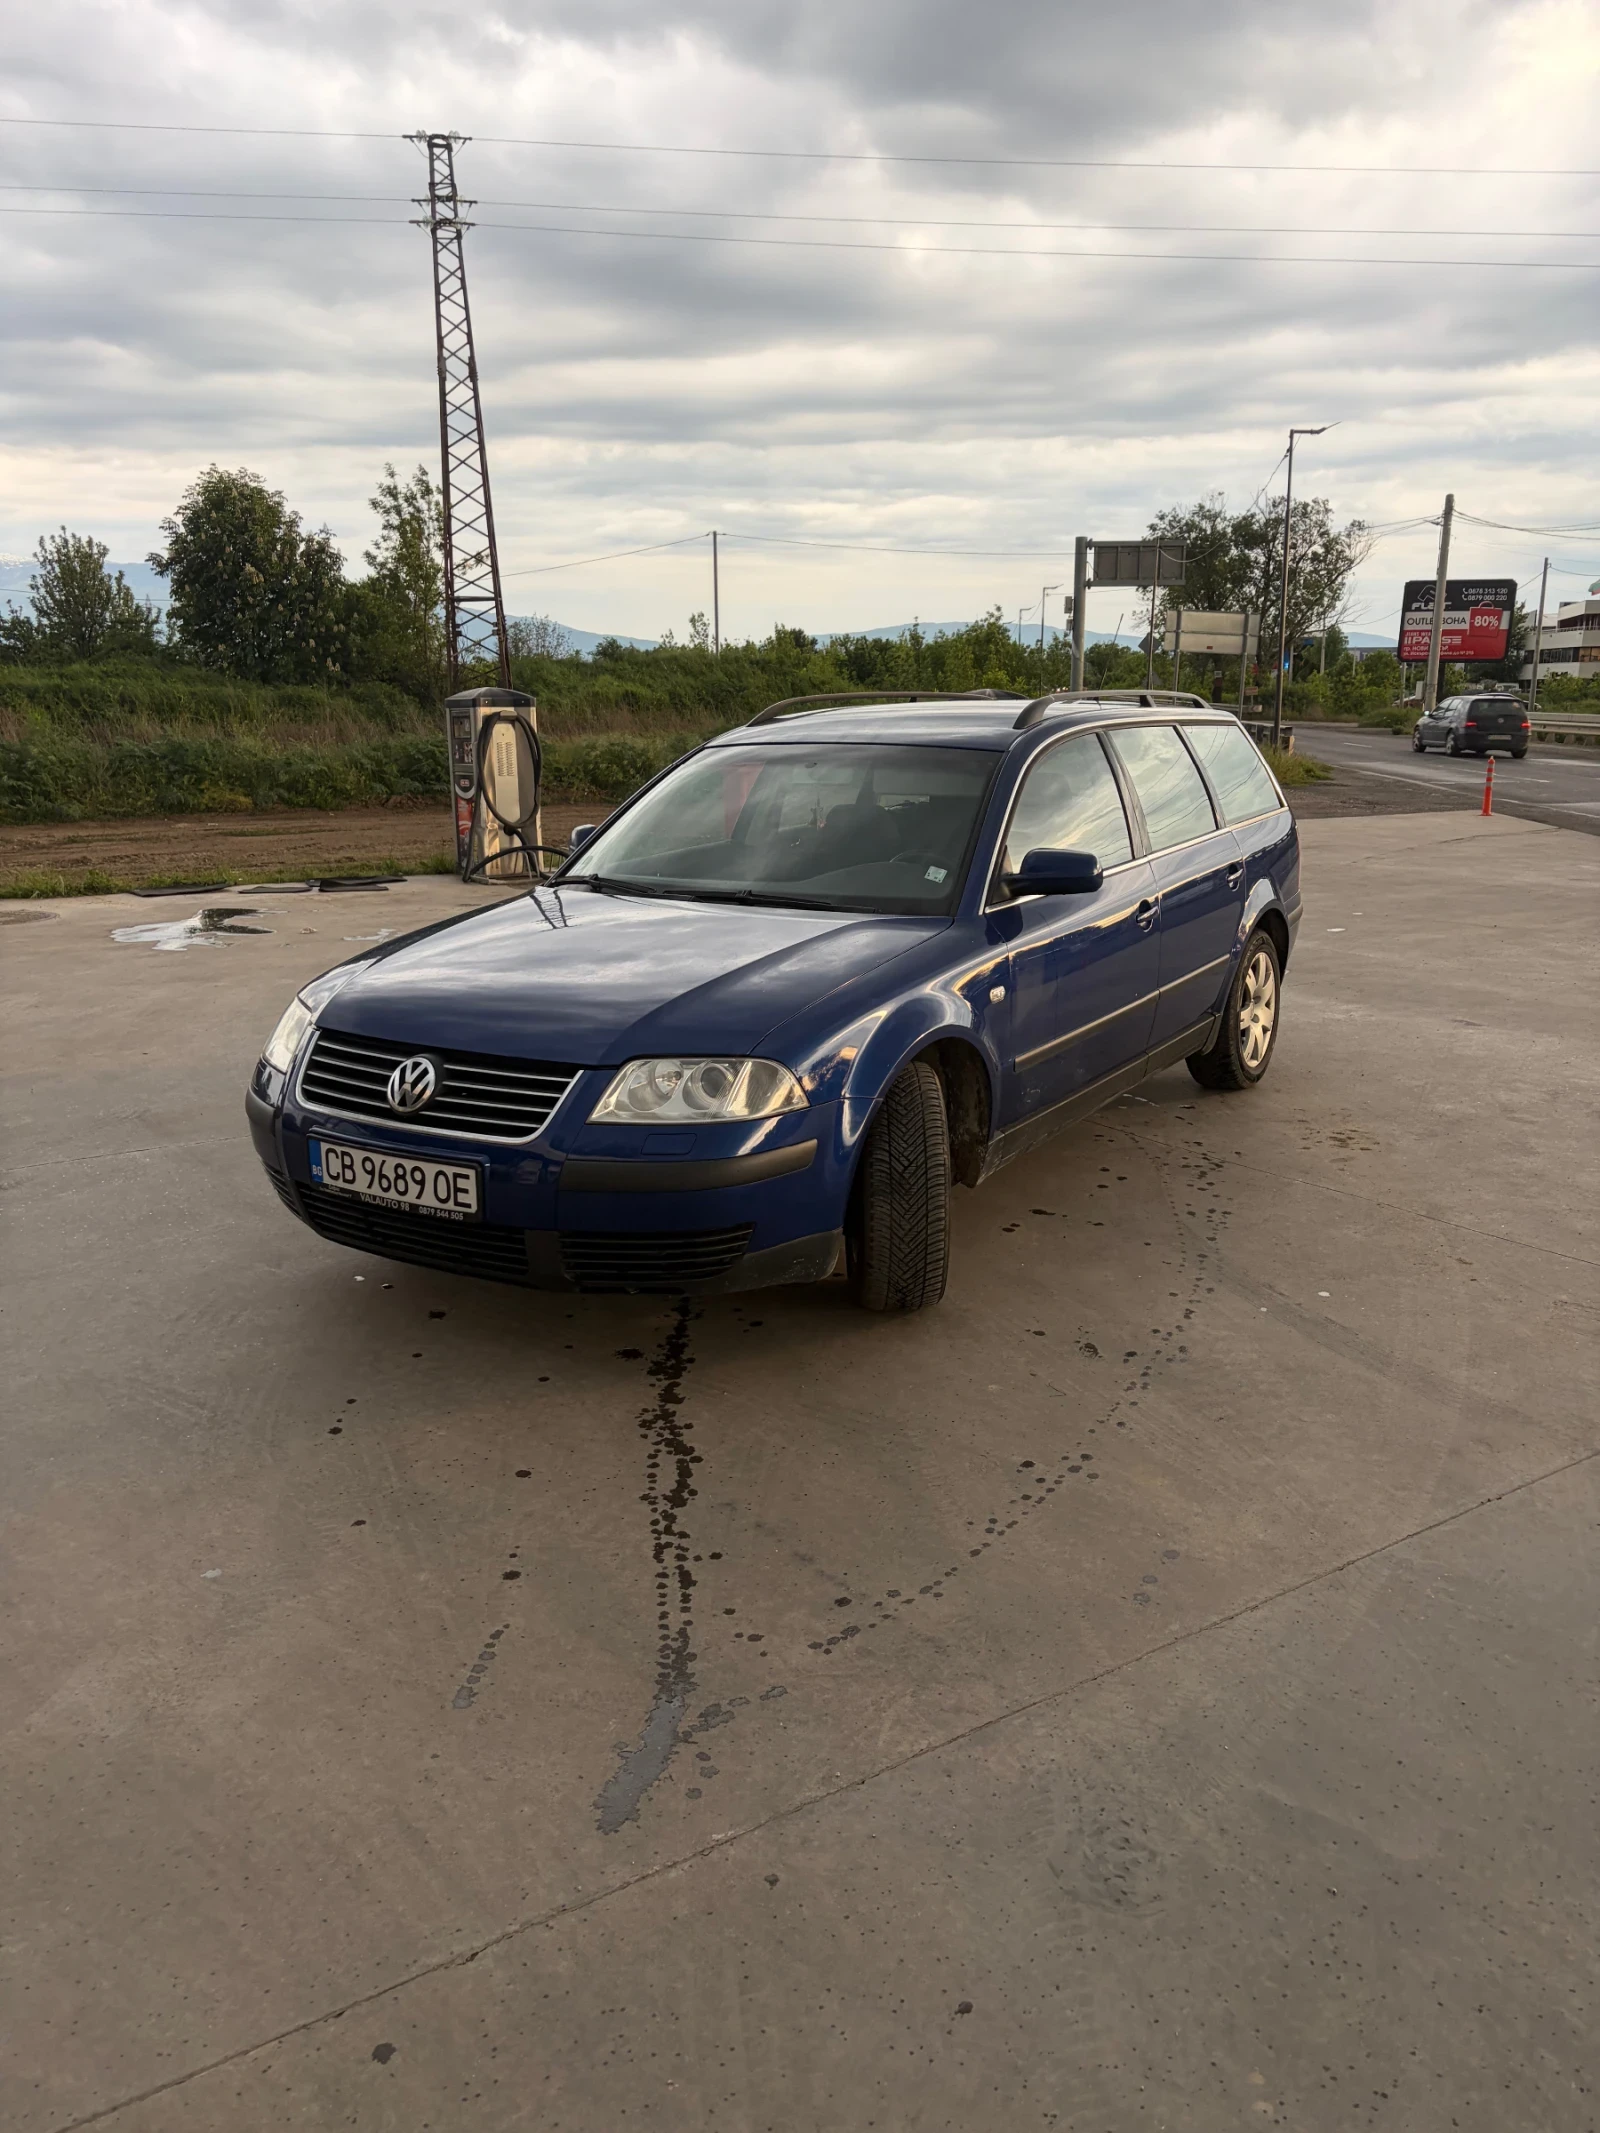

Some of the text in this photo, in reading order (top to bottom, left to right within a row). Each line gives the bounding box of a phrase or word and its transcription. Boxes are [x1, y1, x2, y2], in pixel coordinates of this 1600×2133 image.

[1406, 617, 1434, 626] OUTLE
[312, 1164, 322, 1176] BG
[325, 1147, 356, 1185] CB
[361, 1156, 426, 1200] 9689
[360, 1192, 399, 1210] VALAUTO
[400, 1202, 410, 1211] 98
[418, 1206, 435, 1217] 0879
[436, 1208, 449, 1219] 544
[450, 1210, 464, 1221] 505
